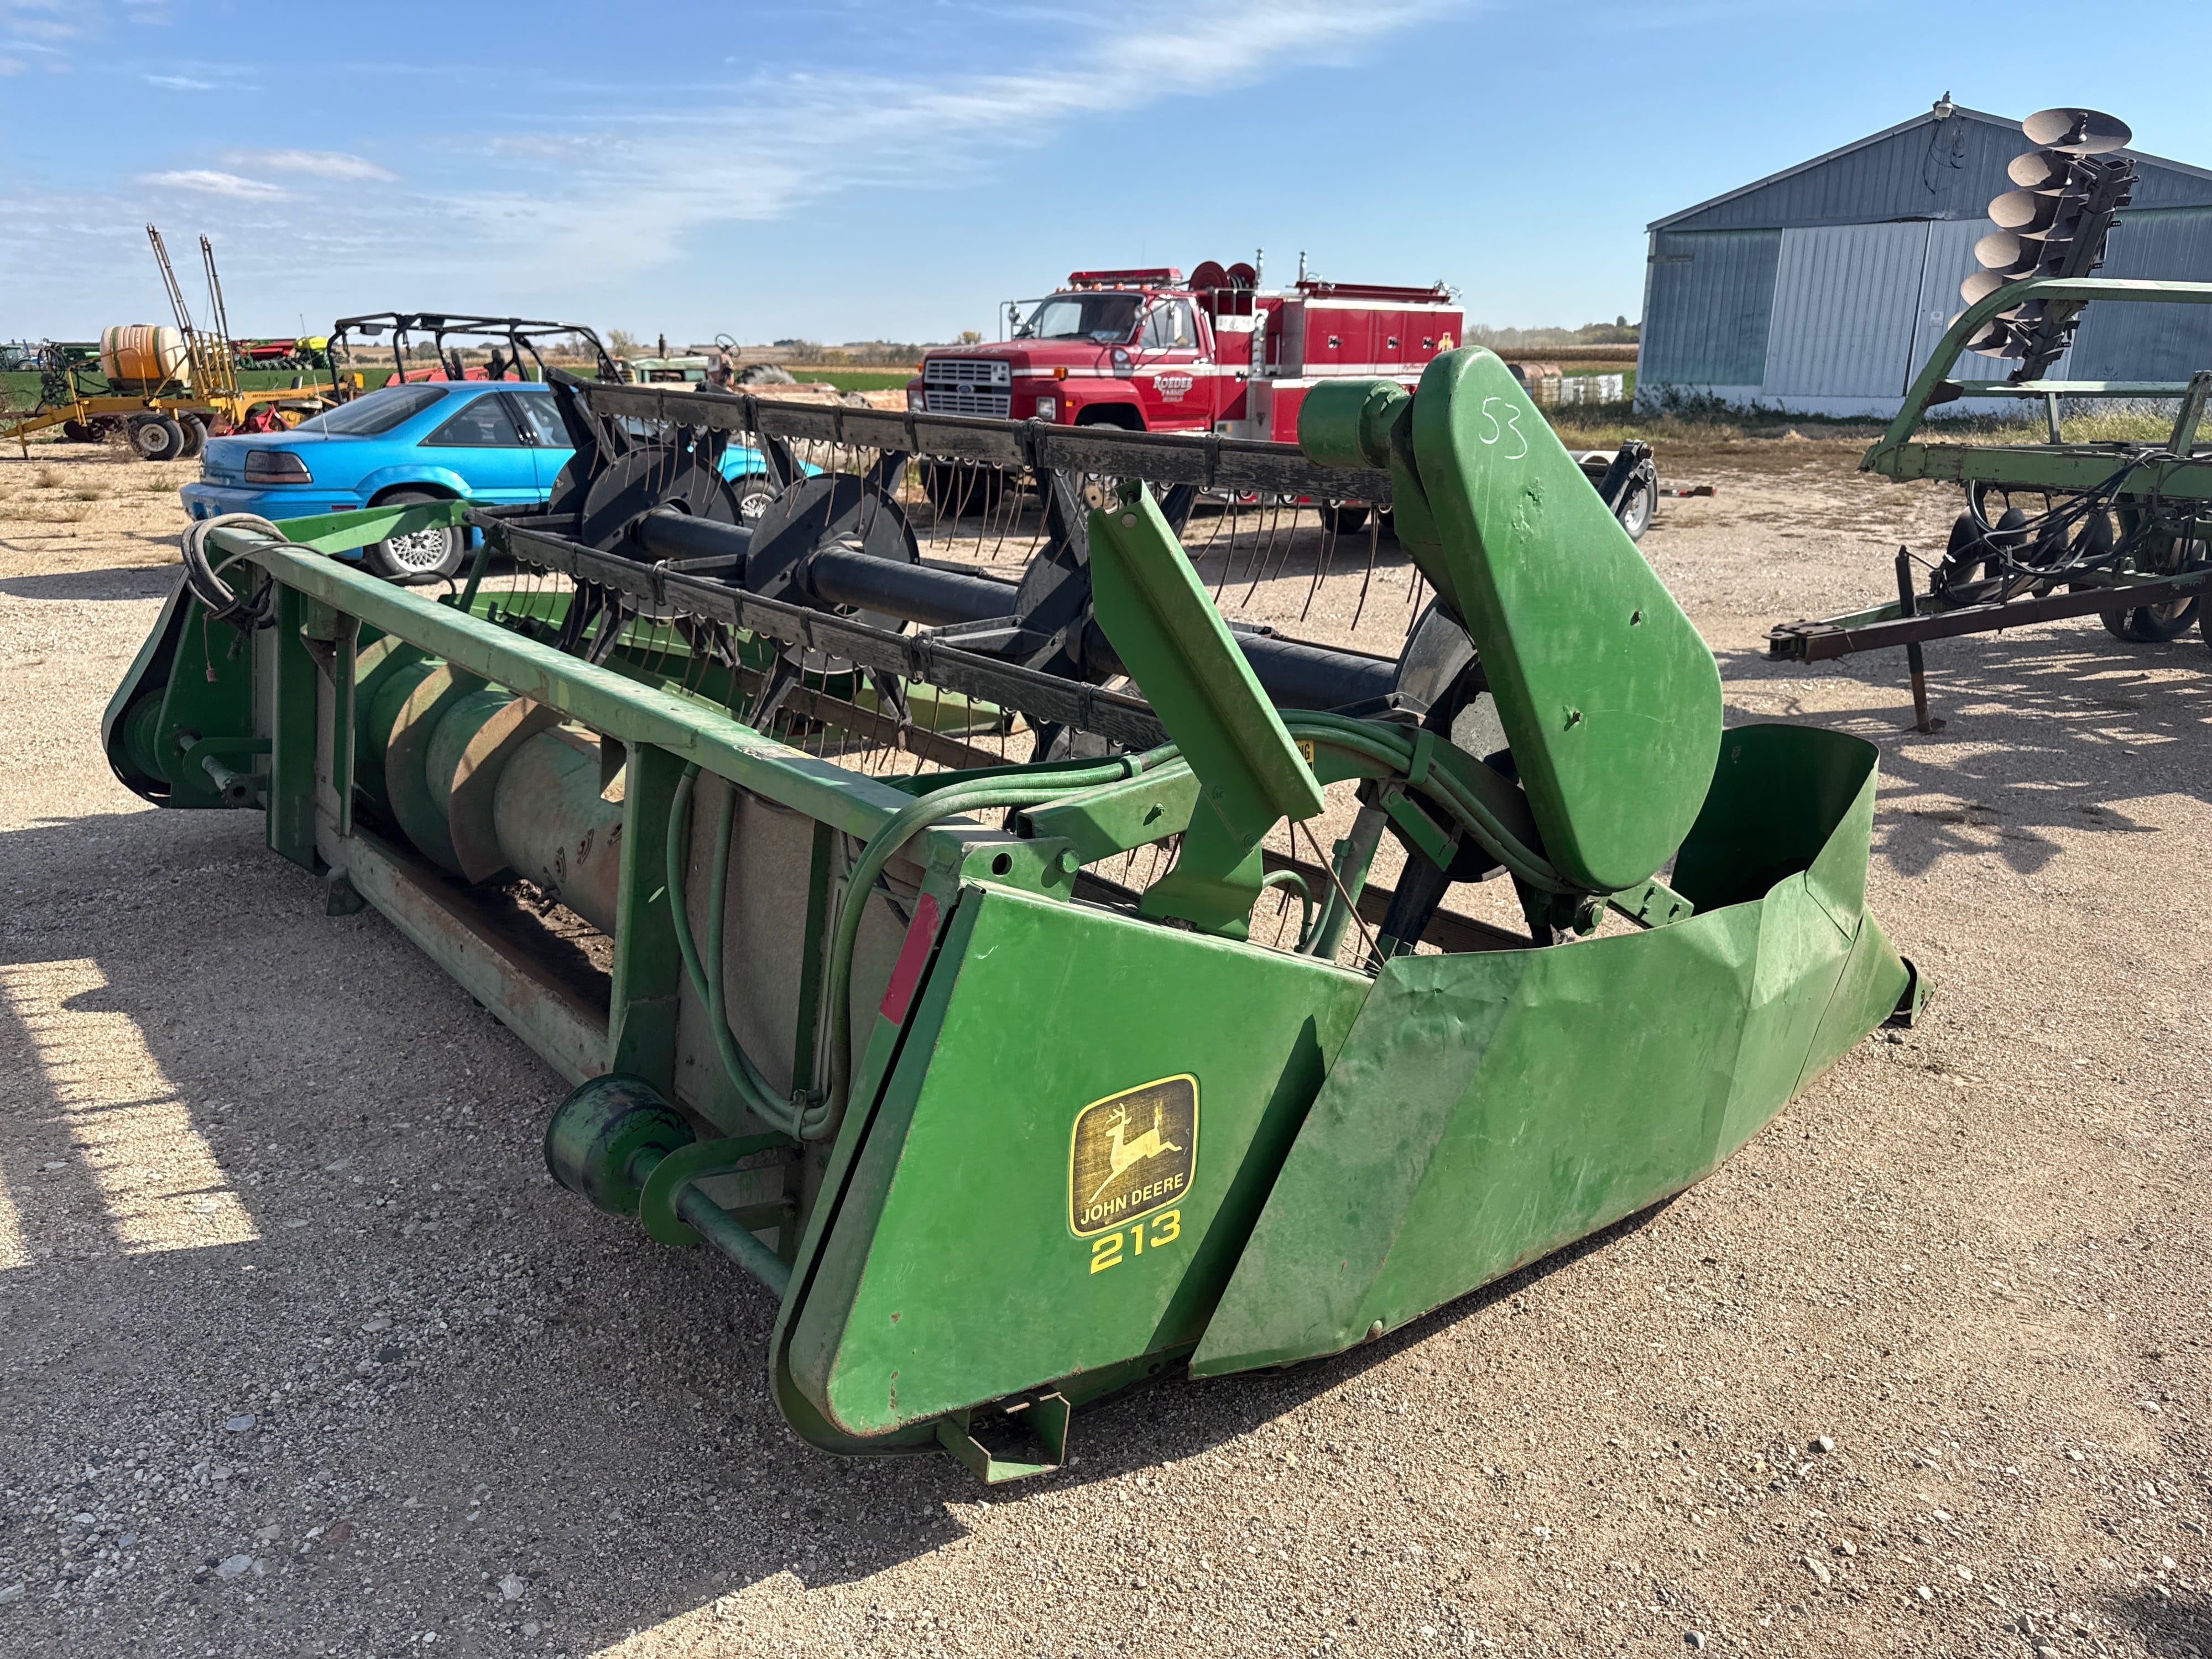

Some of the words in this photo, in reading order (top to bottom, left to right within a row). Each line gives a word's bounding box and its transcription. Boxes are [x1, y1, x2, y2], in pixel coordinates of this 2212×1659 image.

[1479, 396, 1527, 460] 53
[1081, 1194, 1127, 1225] JOHN
[1131, 1172, 1184, 1206] DEERE
[1089, 1209, 1181, 1275] 213
